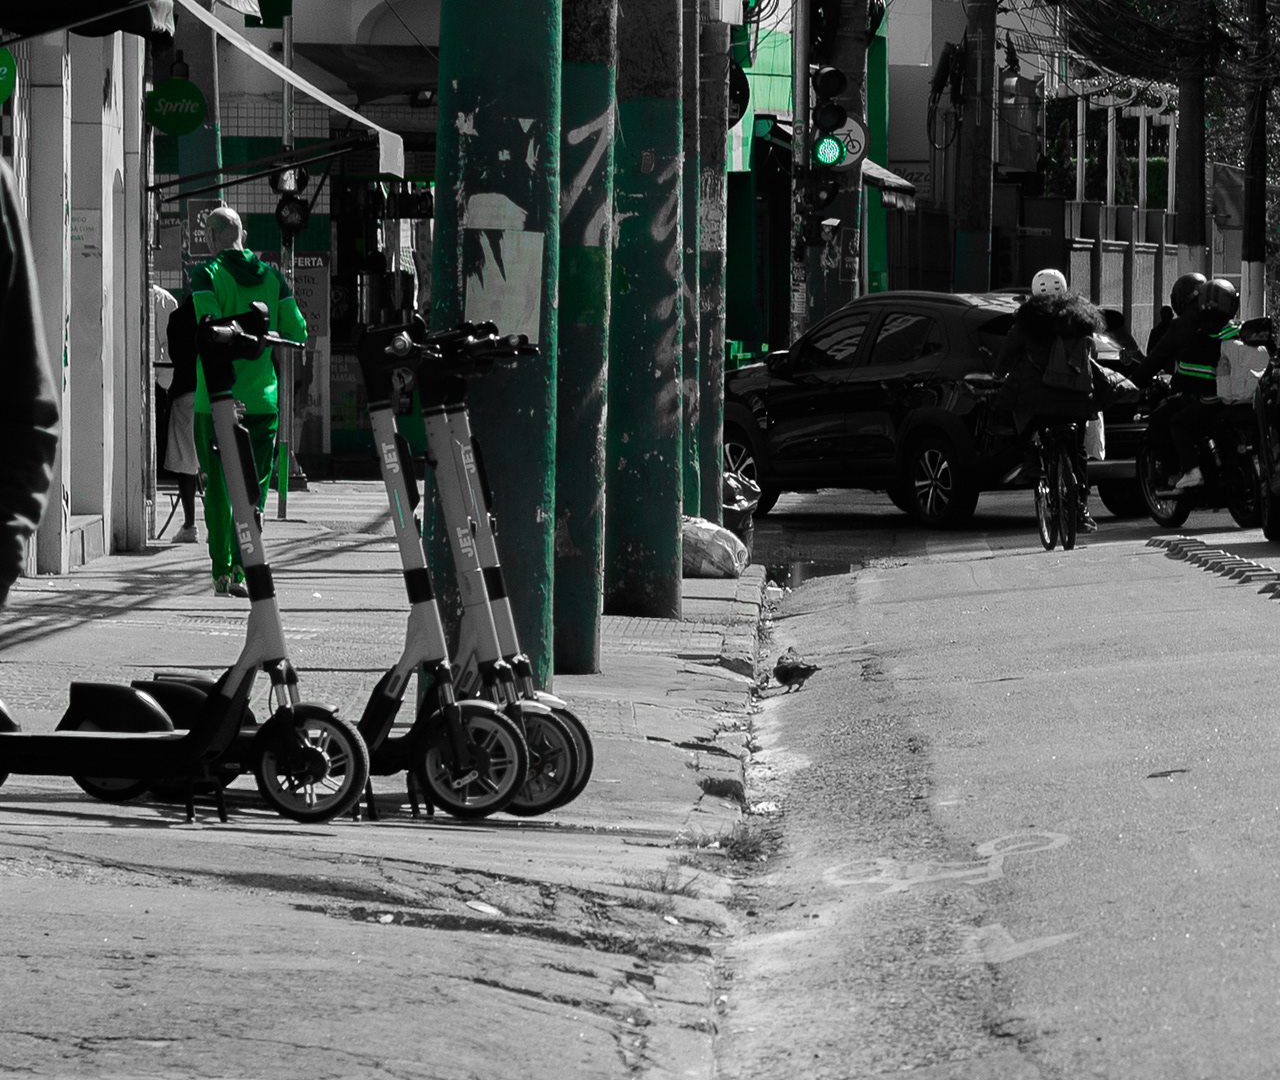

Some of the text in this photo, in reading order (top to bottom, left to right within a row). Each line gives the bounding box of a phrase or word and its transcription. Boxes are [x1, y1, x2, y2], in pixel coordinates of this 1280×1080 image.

[154, 99, 199, 116] Sprite
[382, 442, 400, 474] JET
[461, 444, 476, 474] JET
[236, 522, 254, 554] JET
[456, 527, 474, 557] JET
